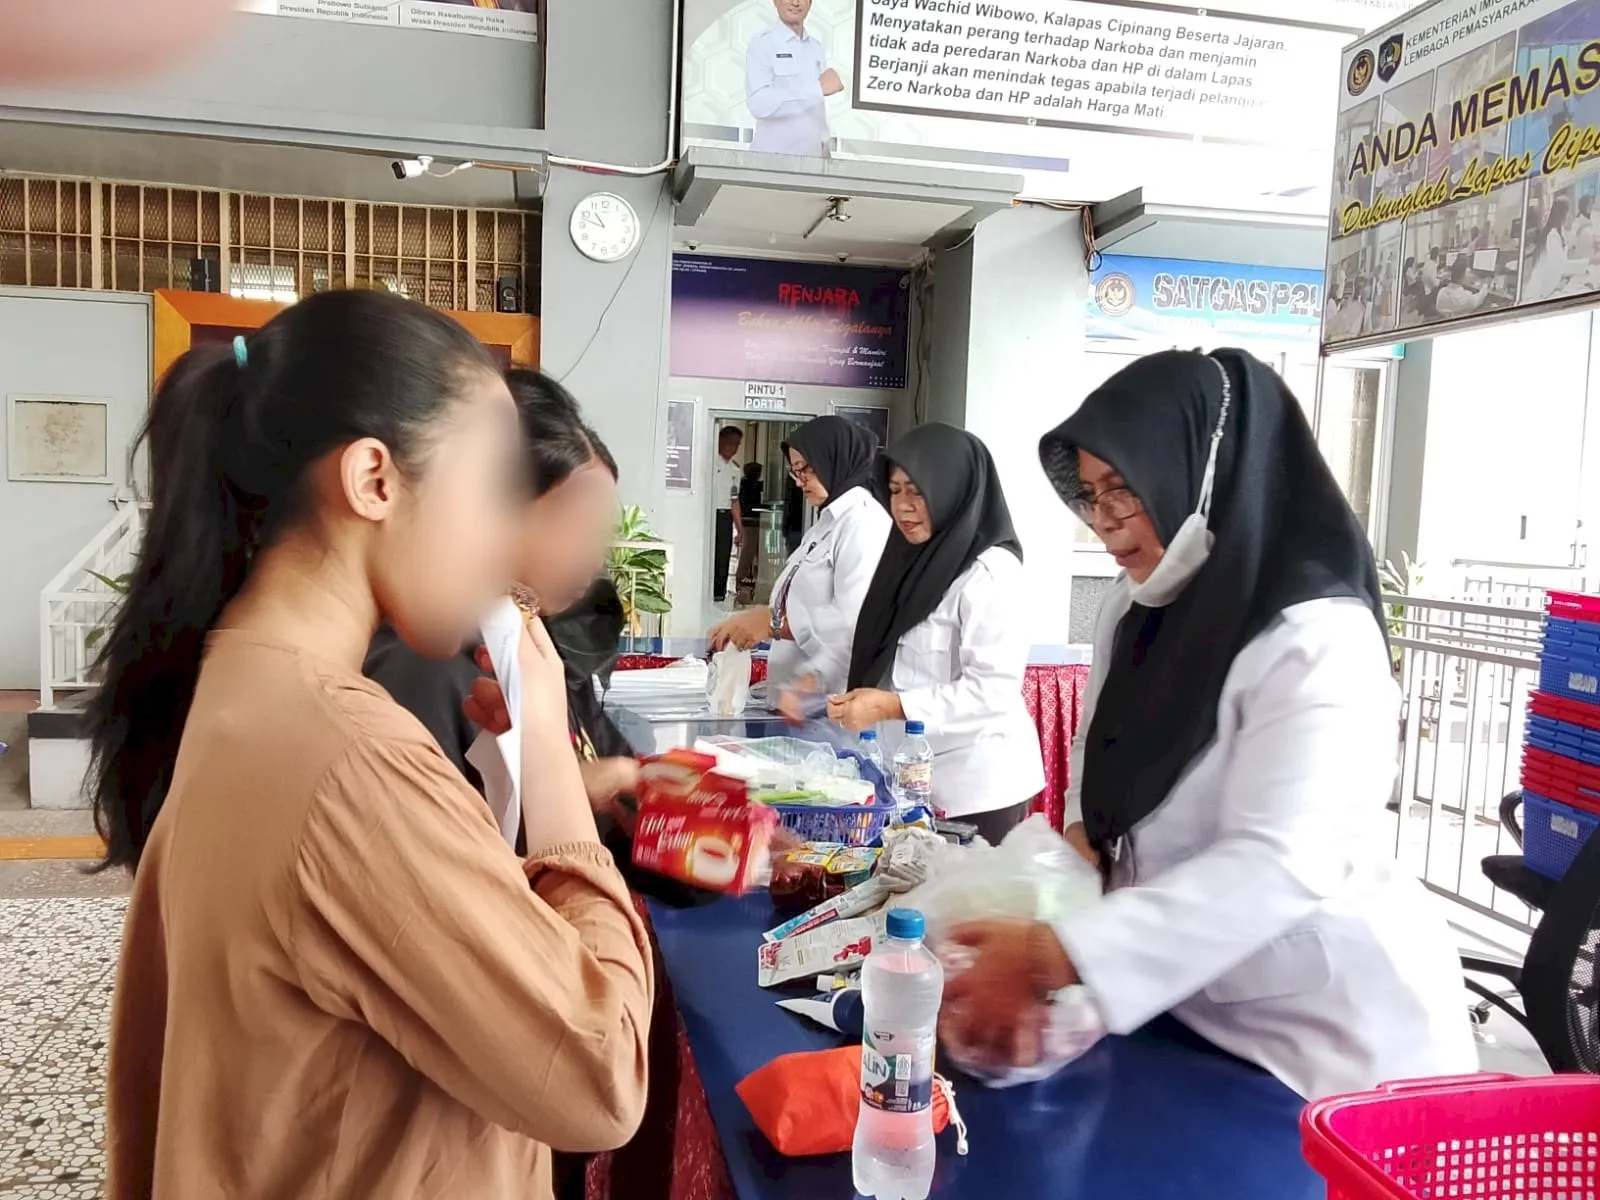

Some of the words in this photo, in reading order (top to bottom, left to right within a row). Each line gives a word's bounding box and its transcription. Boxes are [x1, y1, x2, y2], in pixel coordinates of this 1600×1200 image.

[316, 8, 349, 18] Republik
[914, 0, 971, 15] Wachid
[975, 4, 1039, 24] Wibowo,
[1043, 11, 1102, 32] Kalapas
[1107, 18, 1172, 41] Cipinang
[1175, 26, 1230, 45] Beserta
[1405, 5, 1477, 50] KEMENTERIAN
[869, 12, 963, 36] Menyatakan
[965, 26, 1021, 45] perang
[1023, 29, 1089, 50] terhadap
[1094, 37, 1155, 57] Narkoba
[1158, 45, 1185, 60] dan
[1189, 50, 1257, 69] menjamin
[869, 34, 908, 51] tidak
[911, 39, 940, 54] ada
[943, 45, 1021, 63] peredaran
[1024, 51, 1087, 70] Narkoba
[1091, 57, 1118, 73] dan
[1122, 61, 1144, 75] HP
[1147, 65, 1161, 78] di
[1164, 67, 1207, 83] dalam
[1211, 71, 1253, 88] Lapas
[1404, 37, 1450, 66] LEMBAGA
[866, 76, 903, 93] Zero
[907, 80, 971, 99] Narkoba
[975, 87, 1003, 103] dan
[1008, 90, 1031, 105] HP
[1033, 95, 1083, 110] adalah
[1087, 95, 1130, 117] Harga
[868, 55, 929, 76] Berjanji
[931, 63, 969, 79] akan
[972, 68, 1046, 87] menindak
[1050, 75, 1090, 94] tegas
[1094, 80, 1147, 97] apabila
[1151, 85, 1196, 103] terjadi
[1348, 111, 1438, 181] ANDA
[1449, 41, 1600, 142] MEMAS
[1342, 167, 1448, 236] Dukunglah
[1451, 155, 1533, 198] Lapas
[1152, 273, 1268, 315] SATGAS
[745, 398, 784, 409] PORTIR
[748, 383, 777, 396] PINTU
[779, 386, 784, 396] 1
